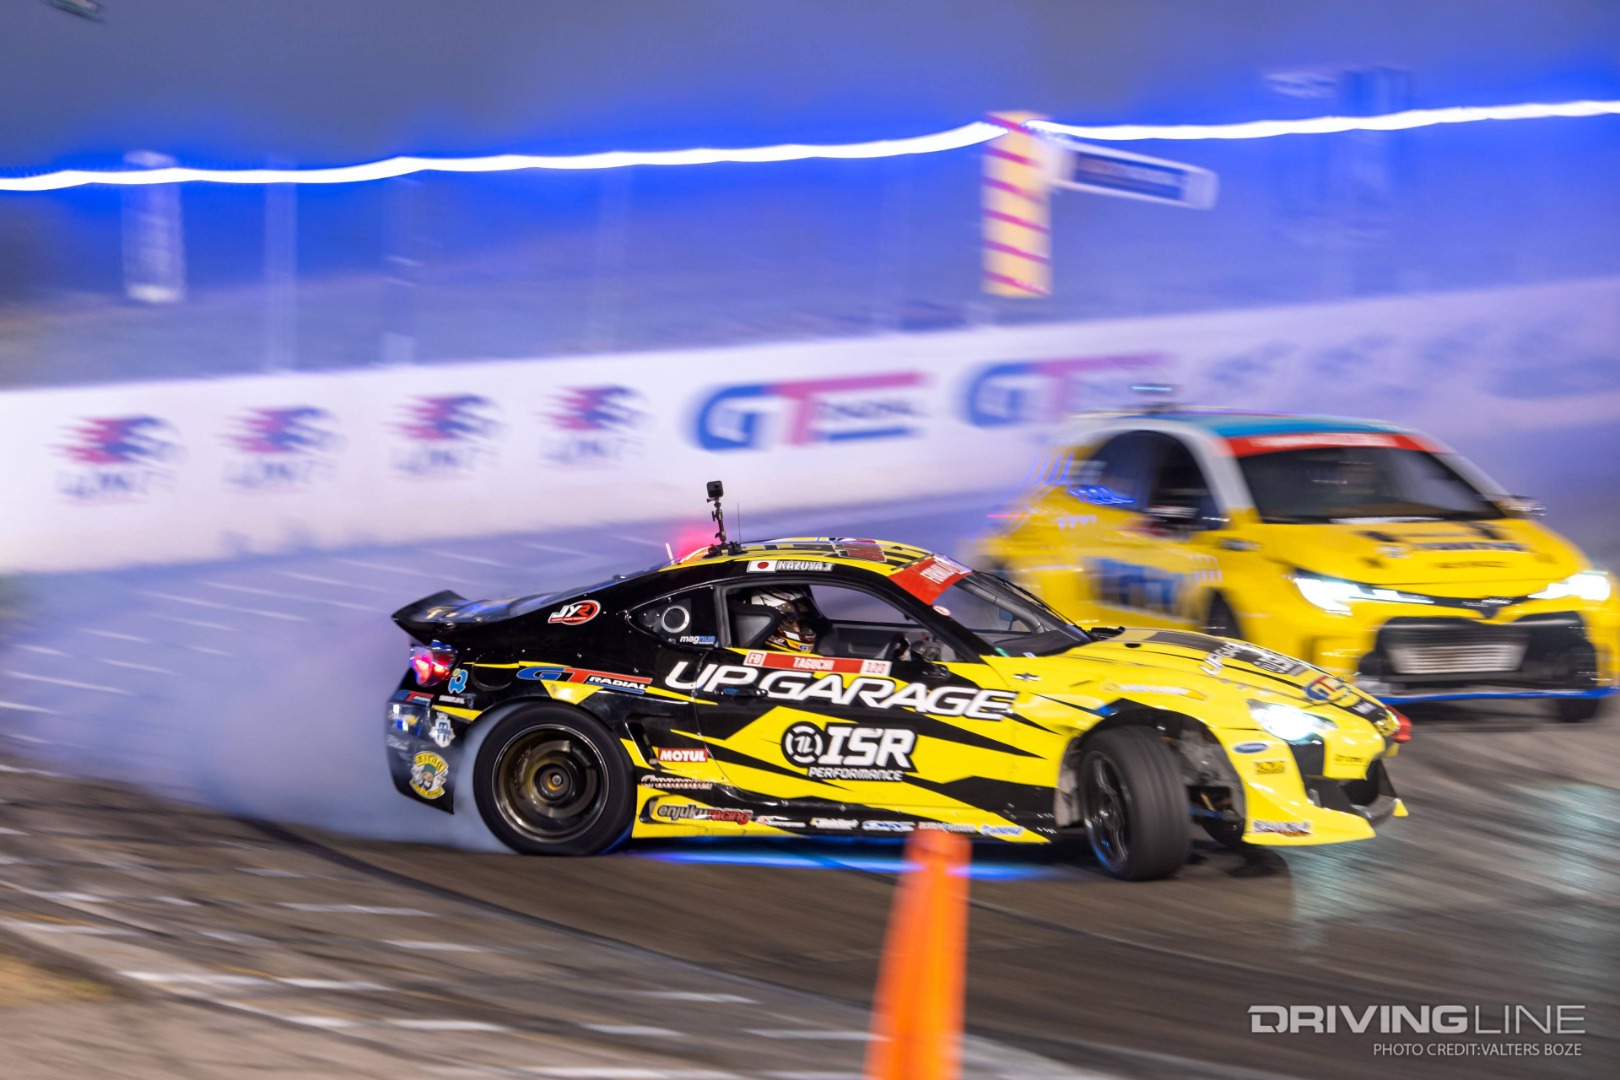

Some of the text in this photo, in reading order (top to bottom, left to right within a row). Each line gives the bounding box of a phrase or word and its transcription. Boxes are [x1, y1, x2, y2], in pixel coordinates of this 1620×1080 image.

[680, 636, 716, 645] magnus
[793, 657, 835, 671] TAGUCHI
[516, 666, 653, 691] GT RADIAL
[665, 661, 1018, 721] UP GARAGE
[818, 726, 916, 768] ISR
[660, 750, 706, 762] MOTUL
[808, 767, 904, 781] PERFORMANCE
